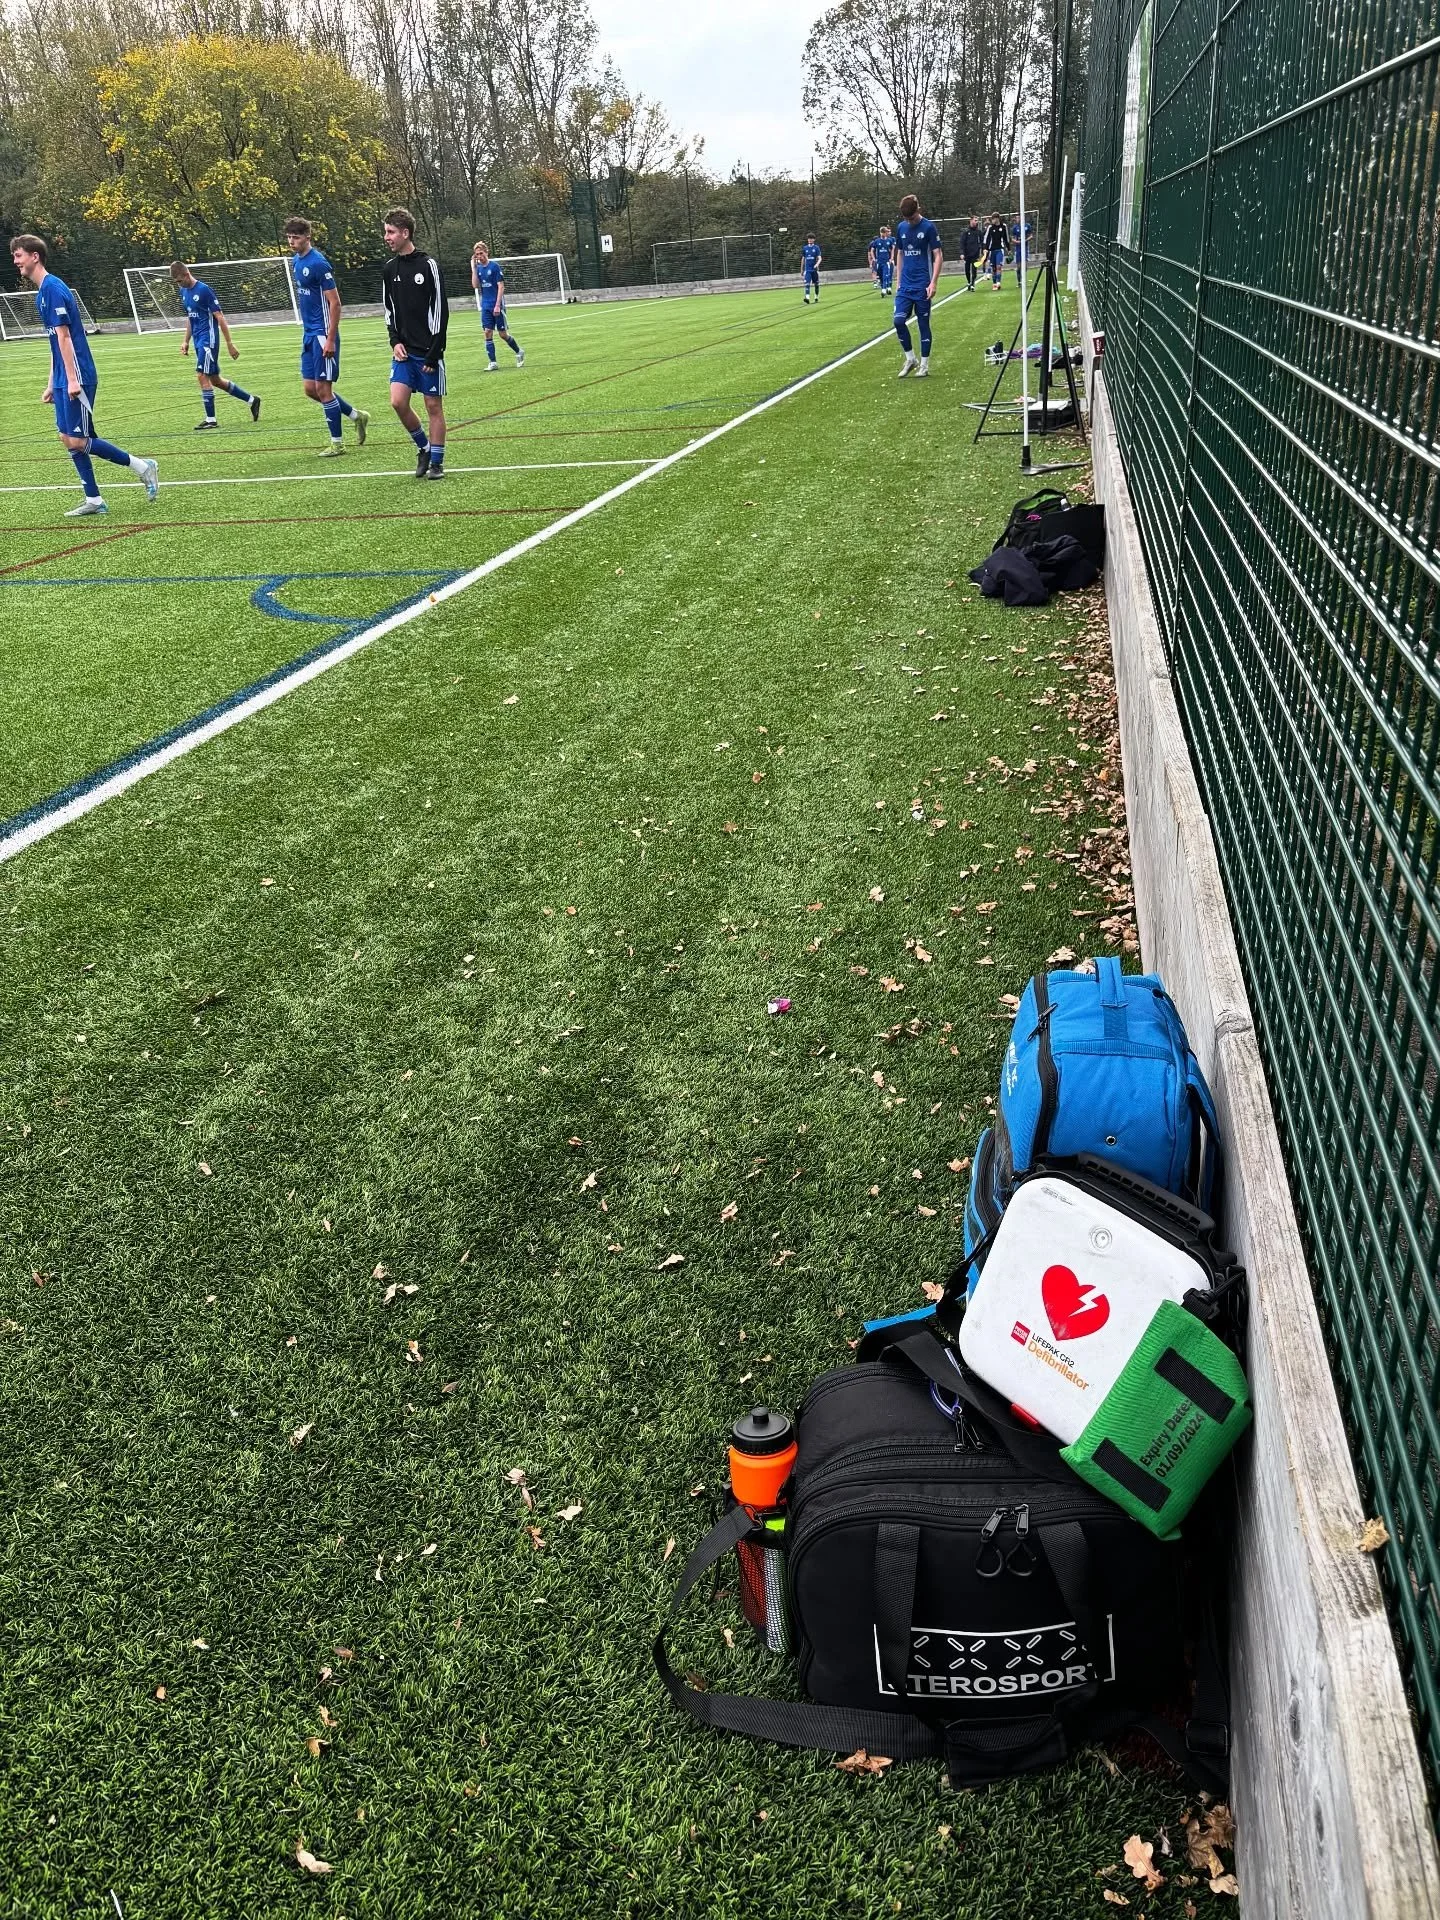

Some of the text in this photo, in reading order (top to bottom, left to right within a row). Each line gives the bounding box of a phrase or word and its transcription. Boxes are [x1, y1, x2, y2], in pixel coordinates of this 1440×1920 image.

[1027, 1340, 1090, 1390] Defibrillator
[1031, 1333, 1060, 1357] LIFEPAK
[1059, 1353, 1075, 1368] CR2
[1140, 1429, 1171, 1467] Expiry
[889, 1663, 1097, 1695] TEROSPOR
